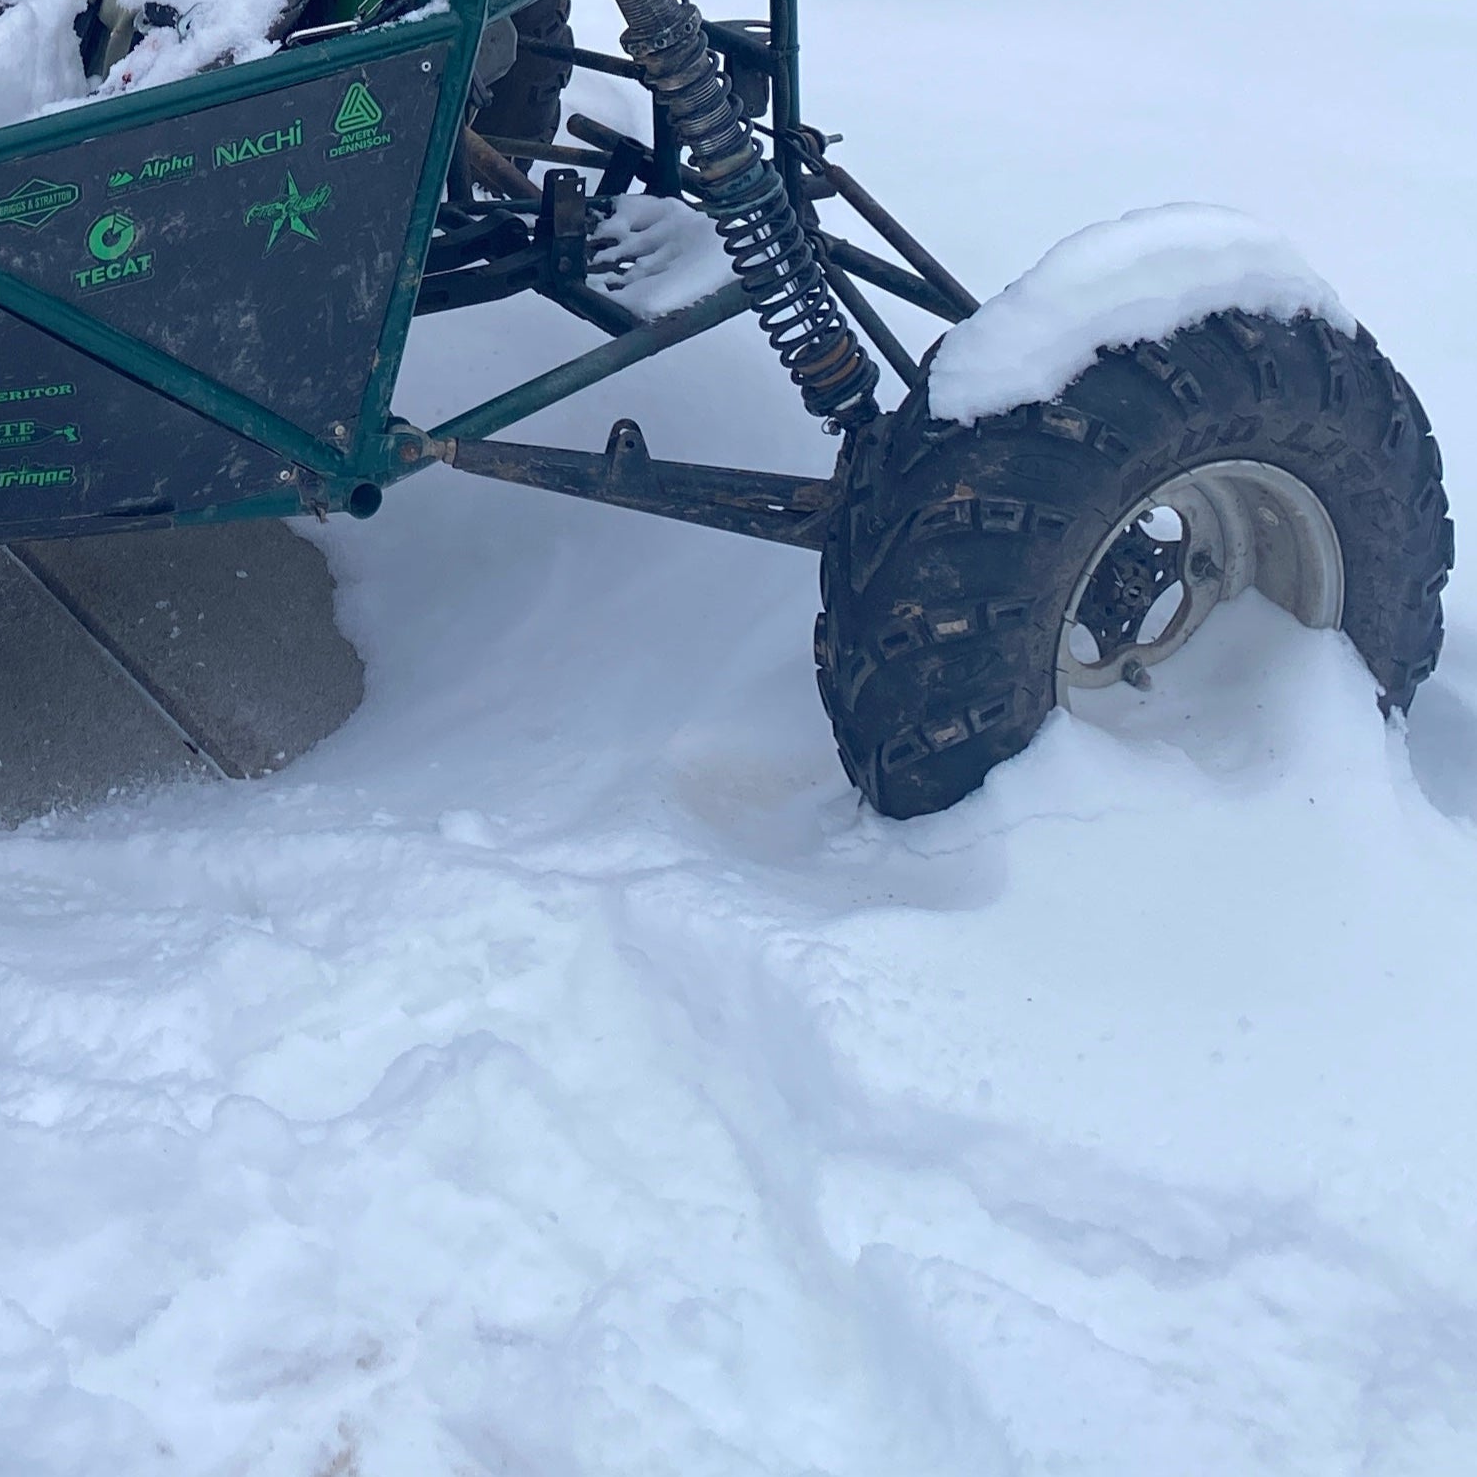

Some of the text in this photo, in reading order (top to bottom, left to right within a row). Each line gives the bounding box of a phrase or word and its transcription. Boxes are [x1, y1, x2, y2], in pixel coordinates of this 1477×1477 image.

[329, 134, 391, 158] DENNISON
[340, 127, 378, 145] AVERY
[139, 155, 194, 180] Alpha
[0, 202, 26, 218] BRIGGS
[34, 189, 72, 209] STRATTON
[75, 254, 152, 288] TECAT
